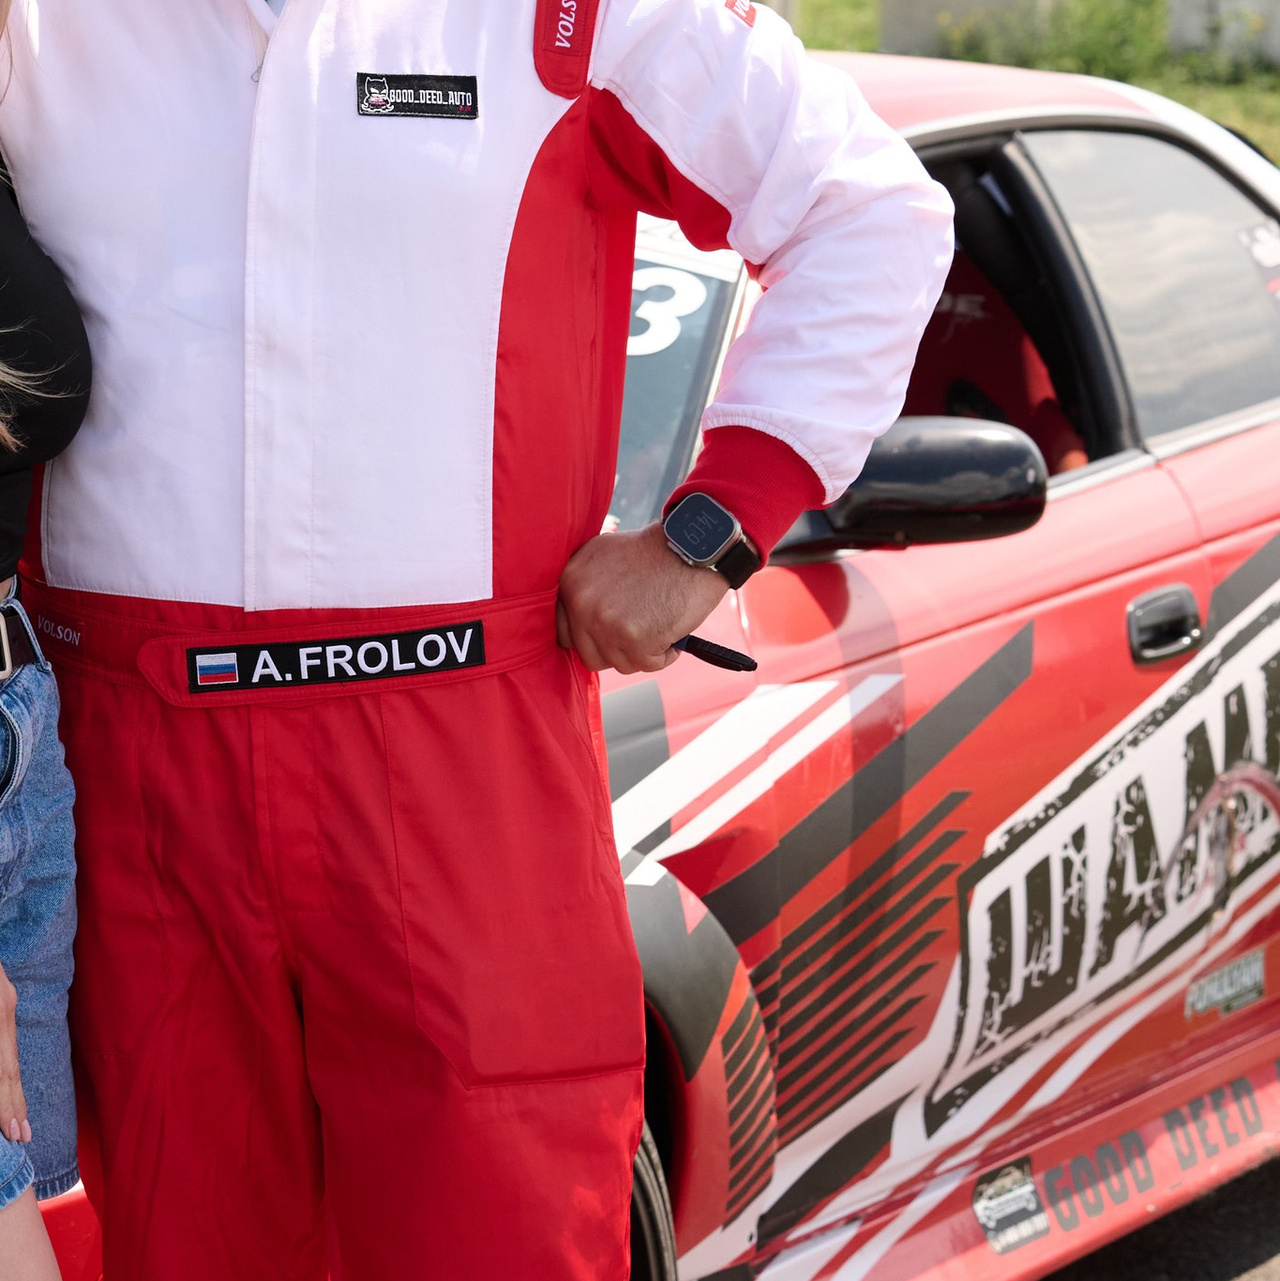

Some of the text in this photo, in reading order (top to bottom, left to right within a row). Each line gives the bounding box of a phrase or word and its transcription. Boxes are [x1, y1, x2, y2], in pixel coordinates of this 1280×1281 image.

[626, 267, 708, 356] 3
[37, 614, 82, 646] VOLSON
[251, 628, 474, 683] A.FROLOV
[1043, 1129, 1155, 1233] GOOD
[1162, 1076, 1264, 1172] DEED
